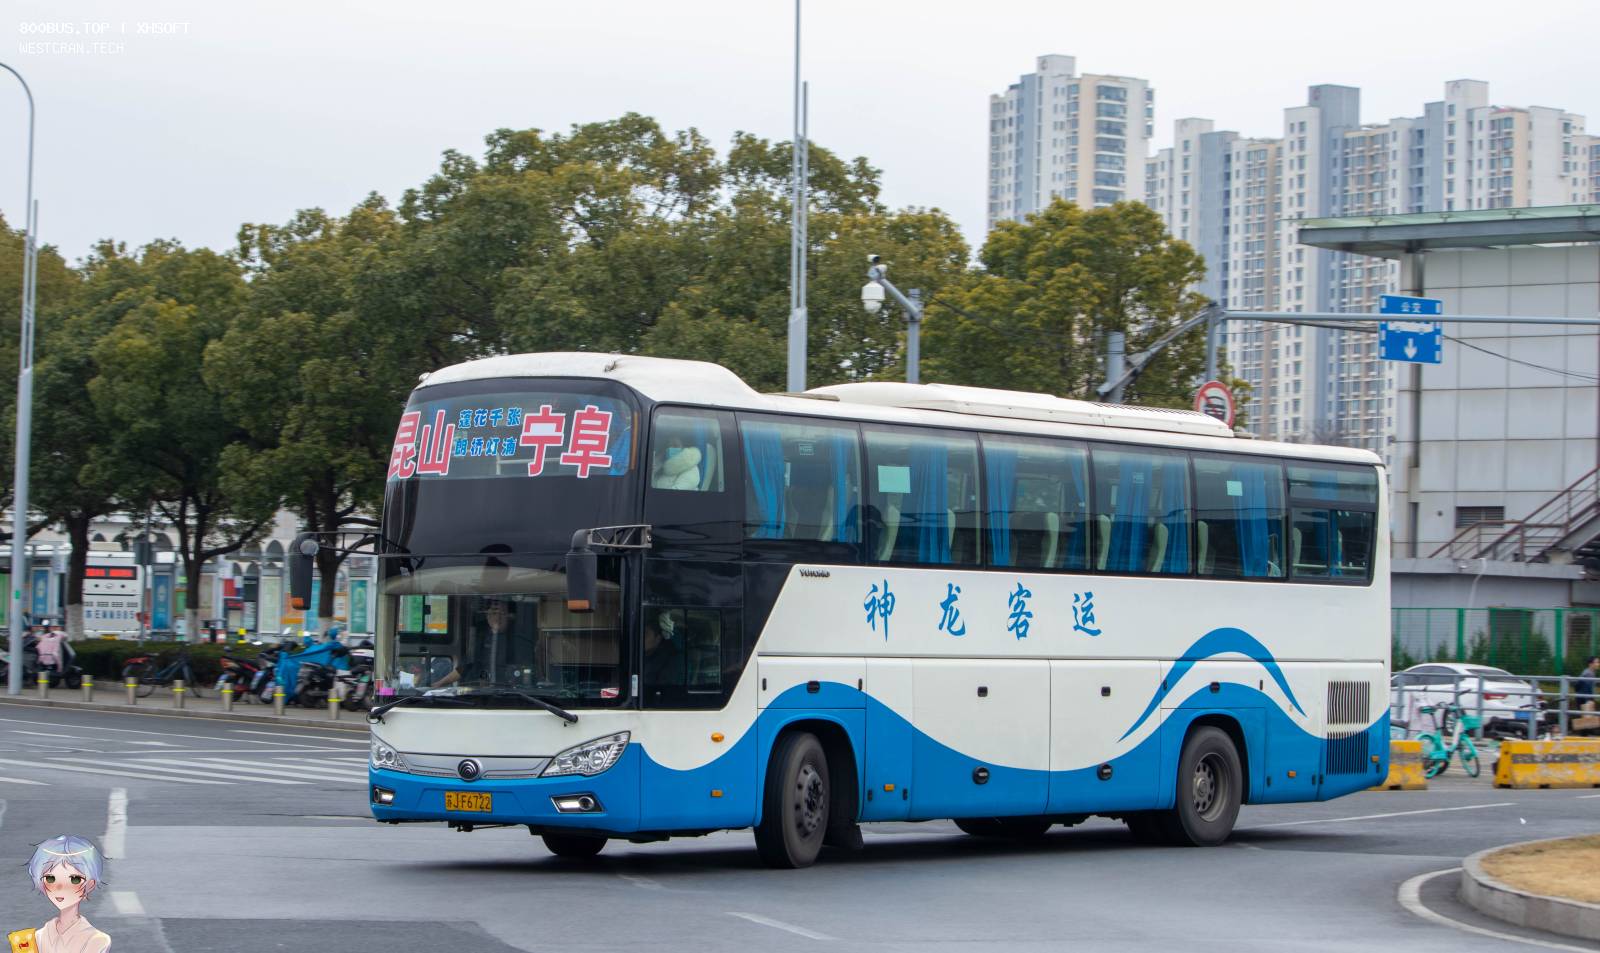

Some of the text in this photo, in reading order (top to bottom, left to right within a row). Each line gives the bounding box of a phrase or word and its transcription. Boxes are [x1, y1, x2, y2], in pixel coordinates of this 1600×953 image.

[1401, 302, 1422, 313] 公交
[864, 579, 1102, 642] 神龙客运
